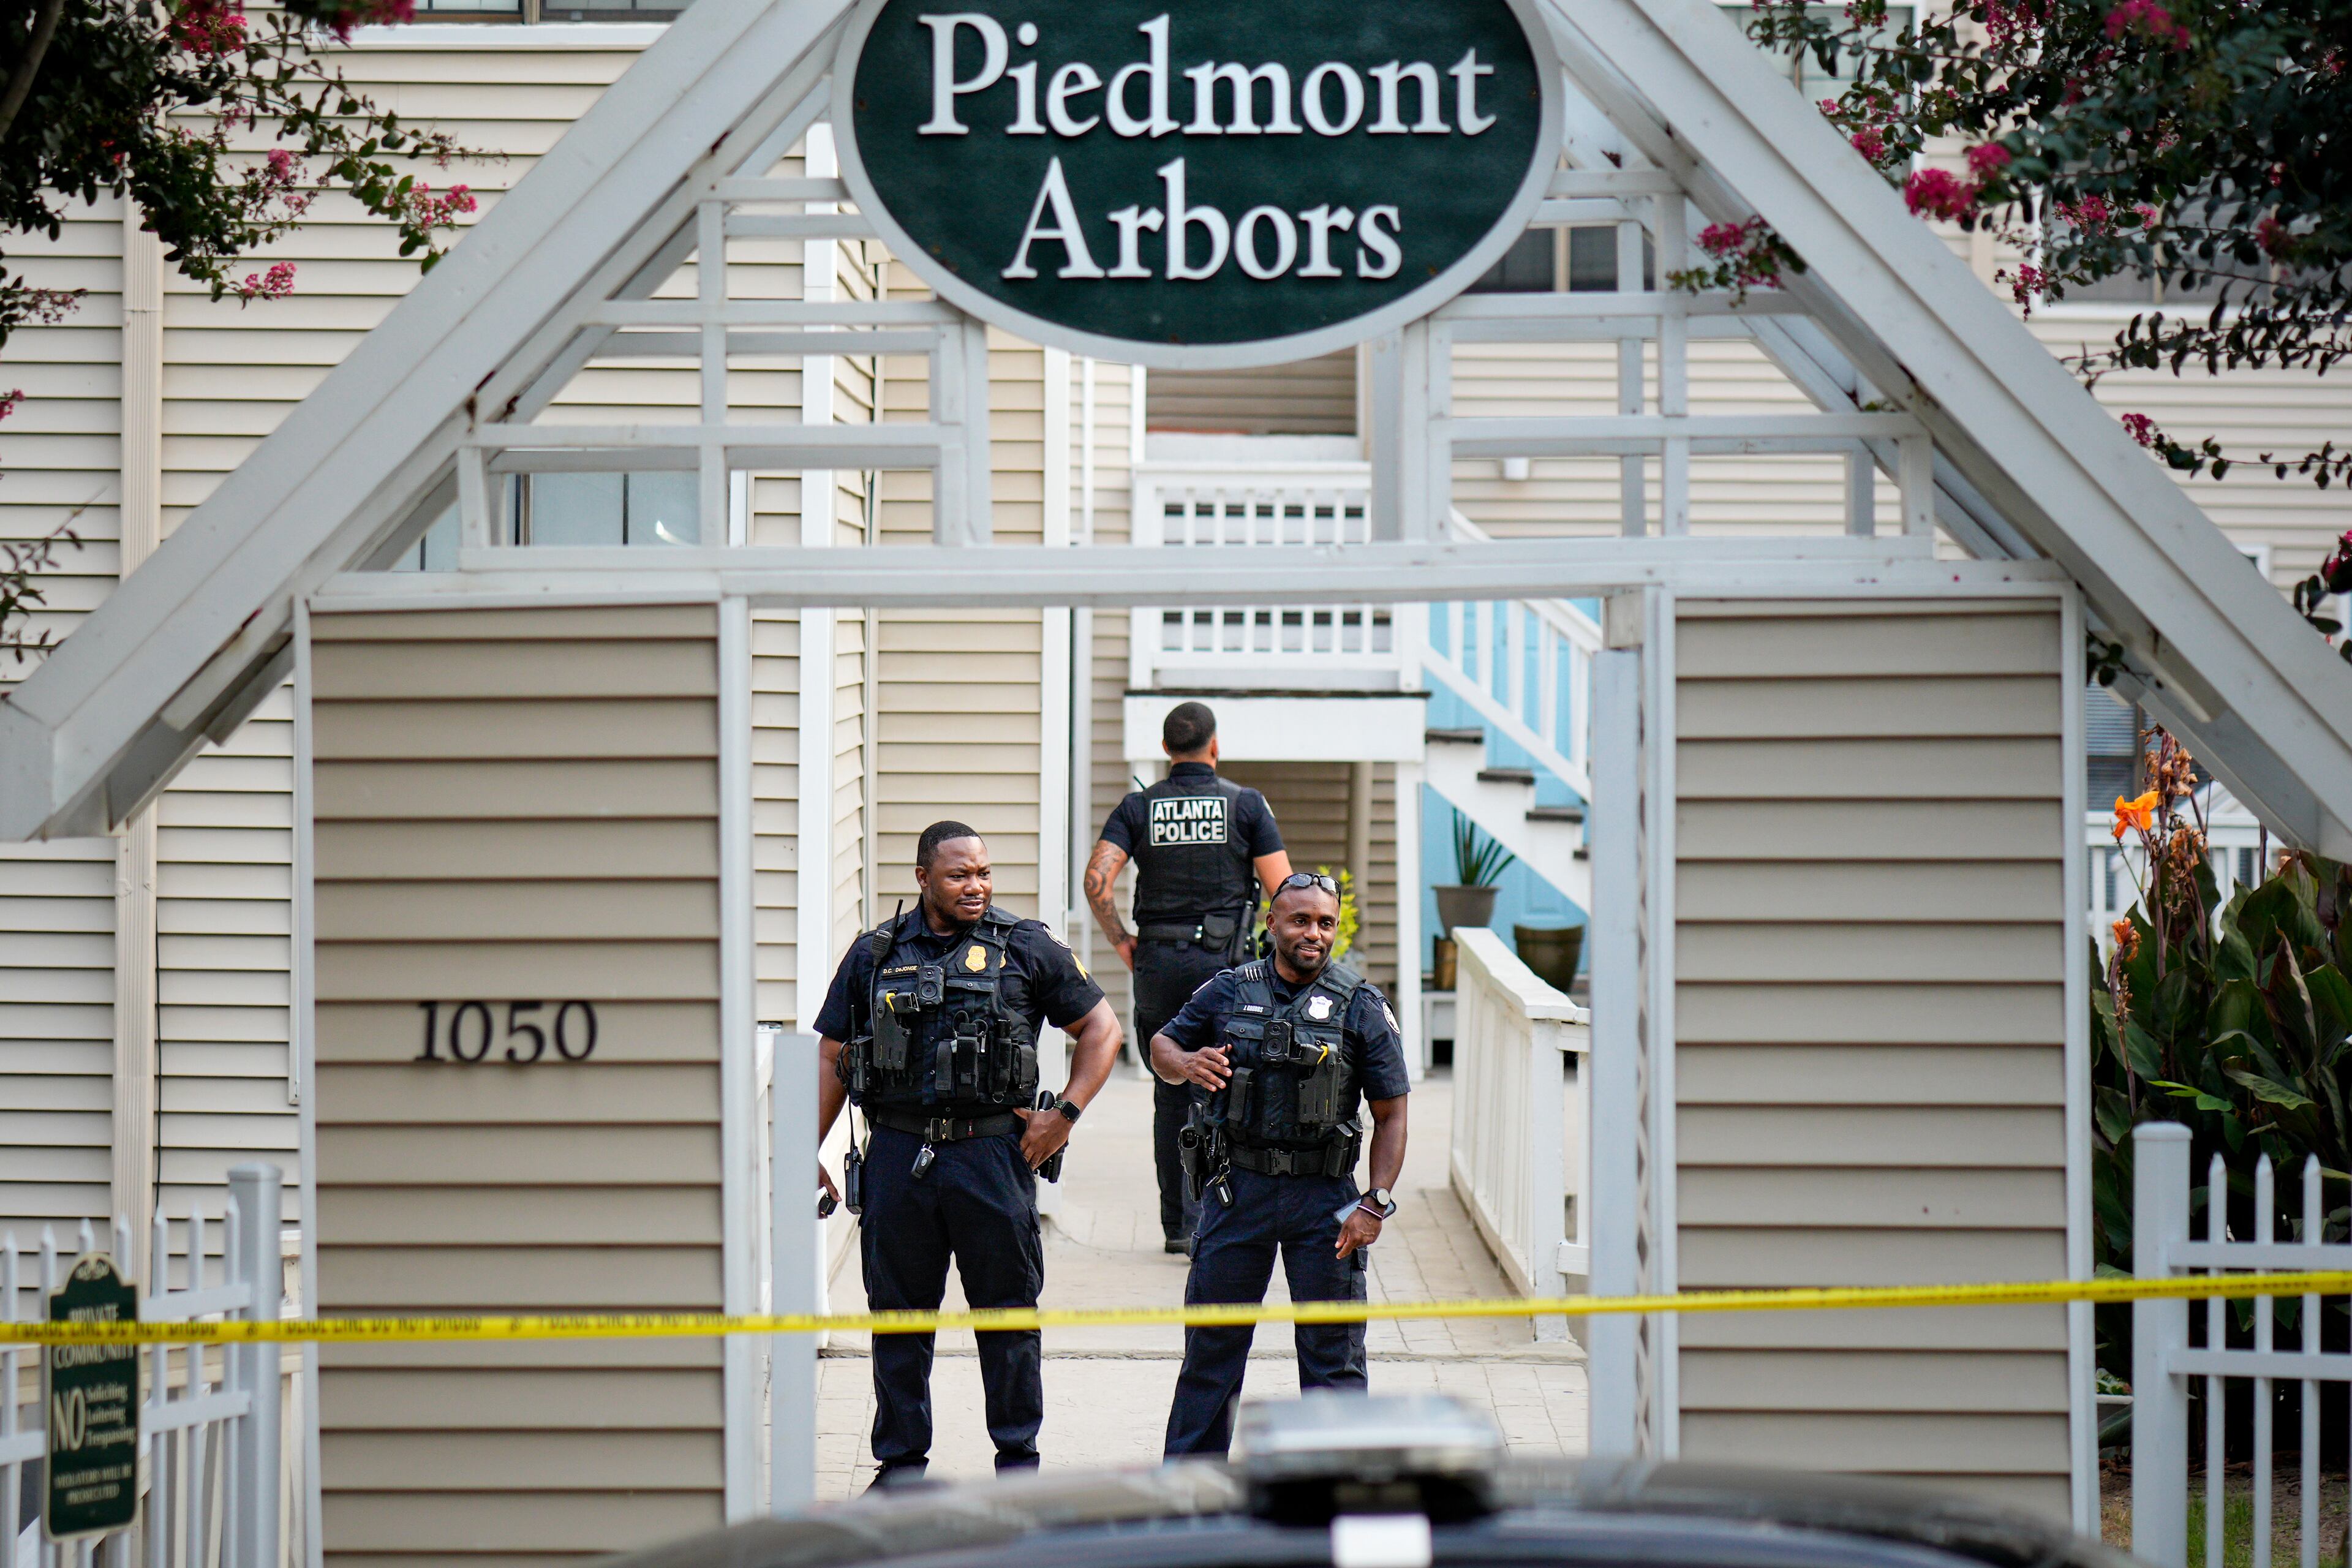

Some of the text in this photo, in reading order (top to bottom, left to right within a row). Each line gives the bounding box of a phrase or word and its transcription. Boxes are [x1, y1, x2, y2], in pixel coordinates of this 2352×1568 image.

[918, 12, 1498, 138] Piedmont
[1001, 156, 1403, 282] Arbors
[1154, 801, 1223, 821] ATLANTA
[1154, 821, 1224, 842] POLICE
[413, 999, 598, 1065] 1050
[51, 1386, 86, 1453] NO
